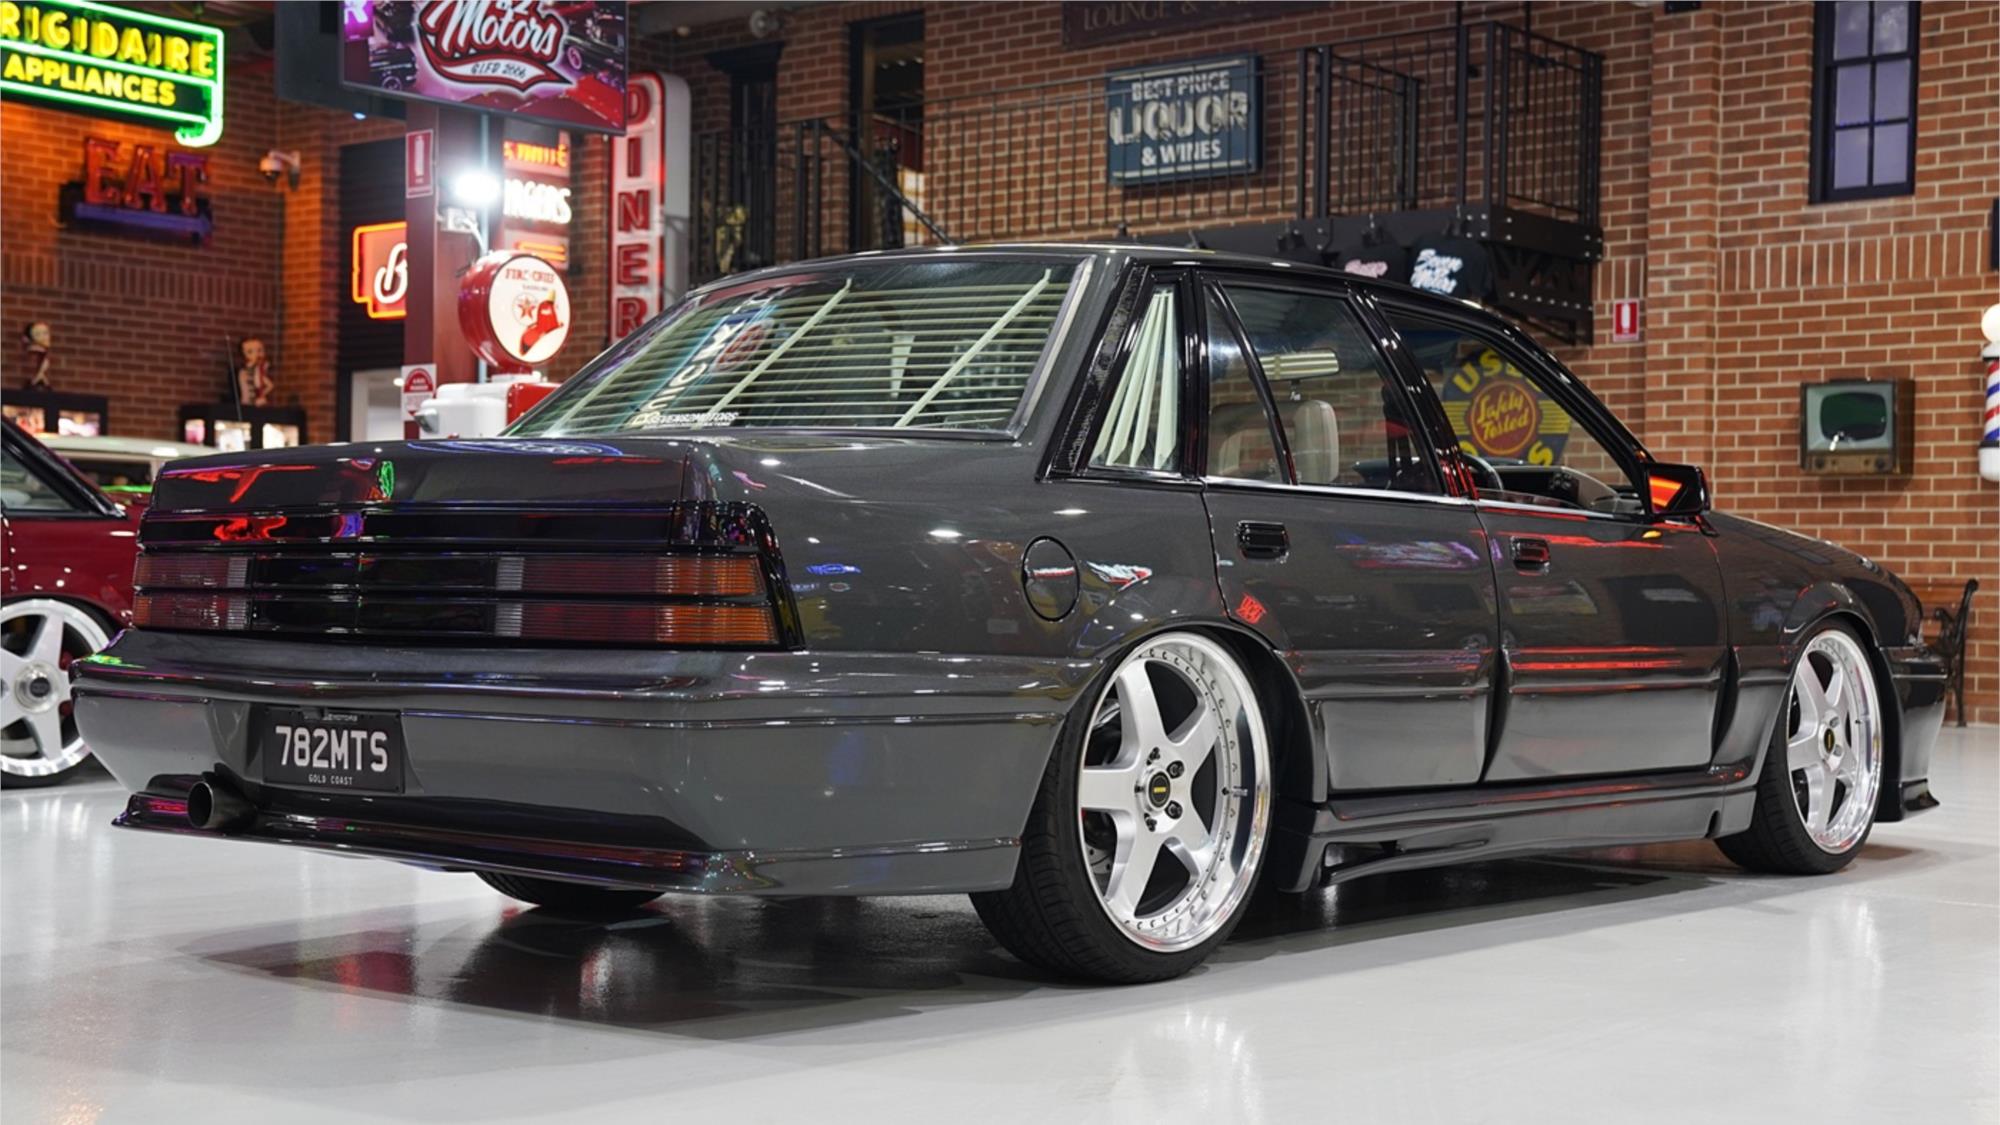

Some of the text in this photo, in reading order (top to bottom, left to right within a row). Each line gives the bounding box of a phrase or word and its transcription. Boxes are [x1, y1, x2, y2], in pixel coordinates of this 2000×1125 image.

[425, 0, 558, 56] Motors
[4, 54, 176, 107] APPLIANCES
[1131, 70, 1230, 102] BEST PRICE
[1109, 90, 1250, 146] LIQUOR
[86, 138, 208, 214] EAT
[1140, 139, 1221, 167] & WINES
[616, 81, 653, 338] DINER
[1476, 388, 1525, 425] Safety
[1481, 405, 1530, 441] Tested
[275, 725, 388, 772] 782MTS
[308, 773, 353, 785] GOLD COAST
